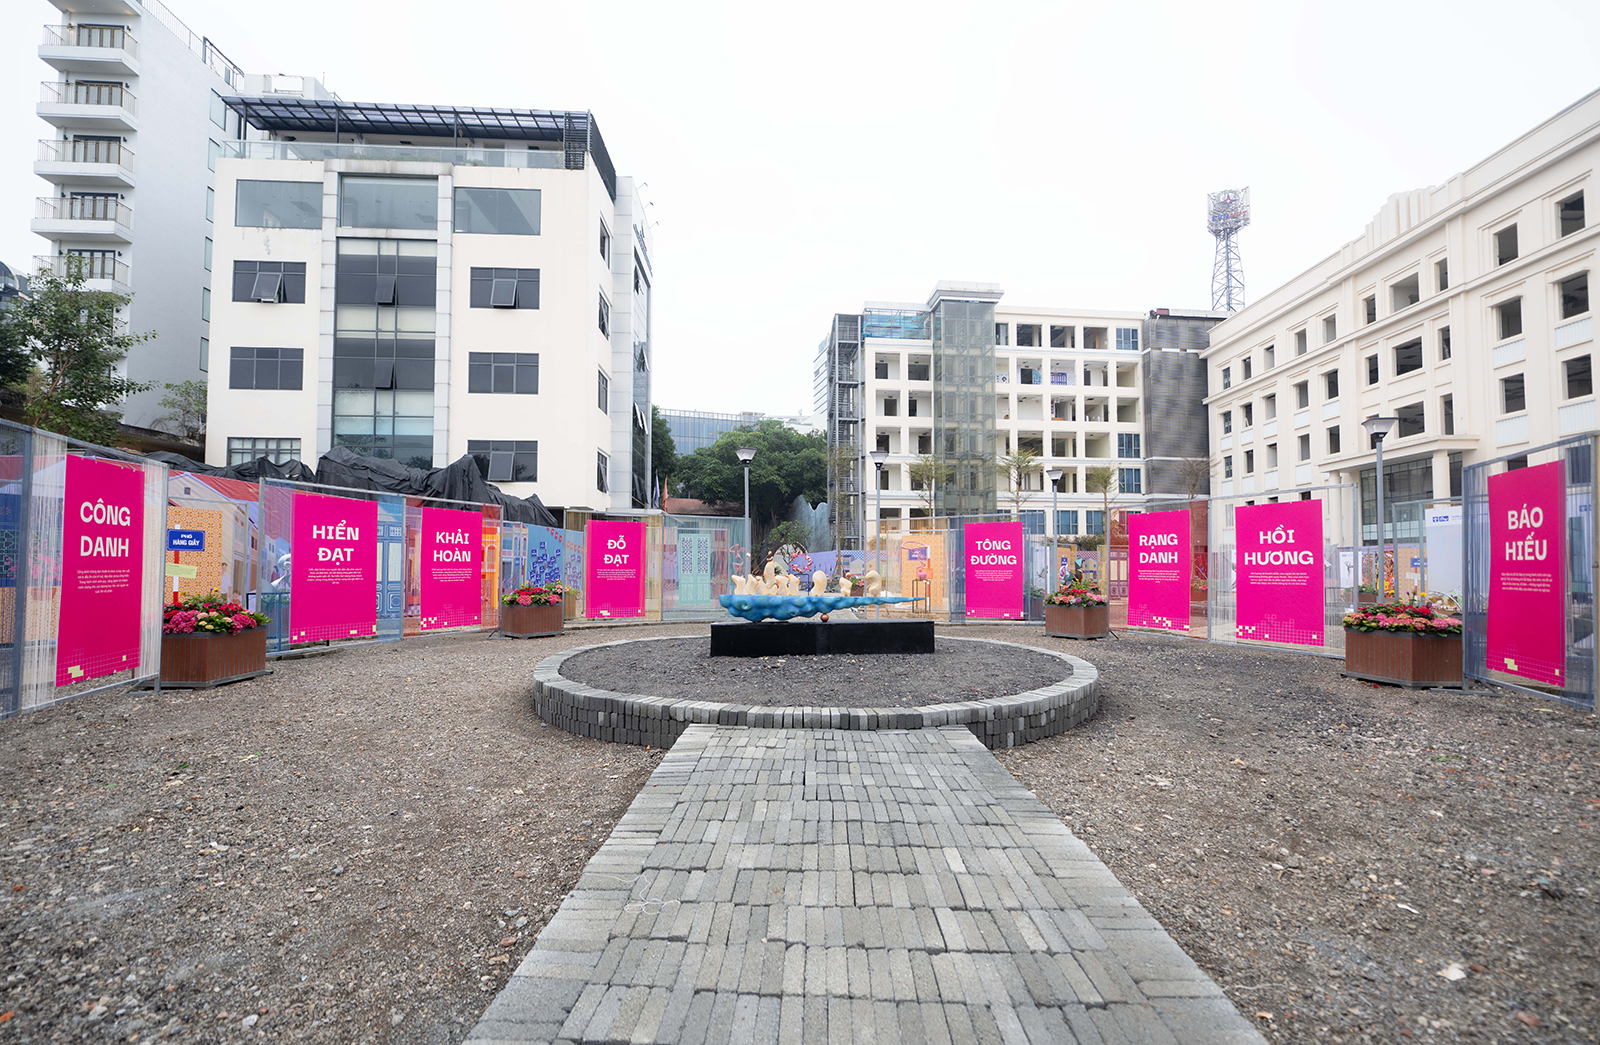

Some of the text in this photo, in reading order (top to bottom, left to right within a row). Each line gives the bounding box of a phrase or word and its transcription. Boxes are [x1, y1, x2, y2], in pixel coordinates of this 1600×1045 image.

[80, 498, 131, 527] CÔNG
[1507, 504, 1544, 530] BÁO
[312, 519, 360, 541] HIỂN
[435, 529, 470, 545] KHẢI
[1259, 524, 1295, 545] HỒI
[80, 535, 129, 557] DANH
[172, 538, 187, 546] HÀNG
[606, 534, 627, 550] ĐỖ
[975, 538, 1012, 551] TÔNG
[1139, 533, 1178, 550] RẠNG
[1505, 532, 1547, 561] HIẾU
[317, 547, 355, 566] ĐẠT
[433, 547, 471, 562] HOÀN
[603, 554, 630, 567] ĐẠT
[970, 552, 1017, 566] ĐƯỜNG
[1139, 551, 1178, 564] DANH
[1244, 550, 1314, 566] HƯƠNG
